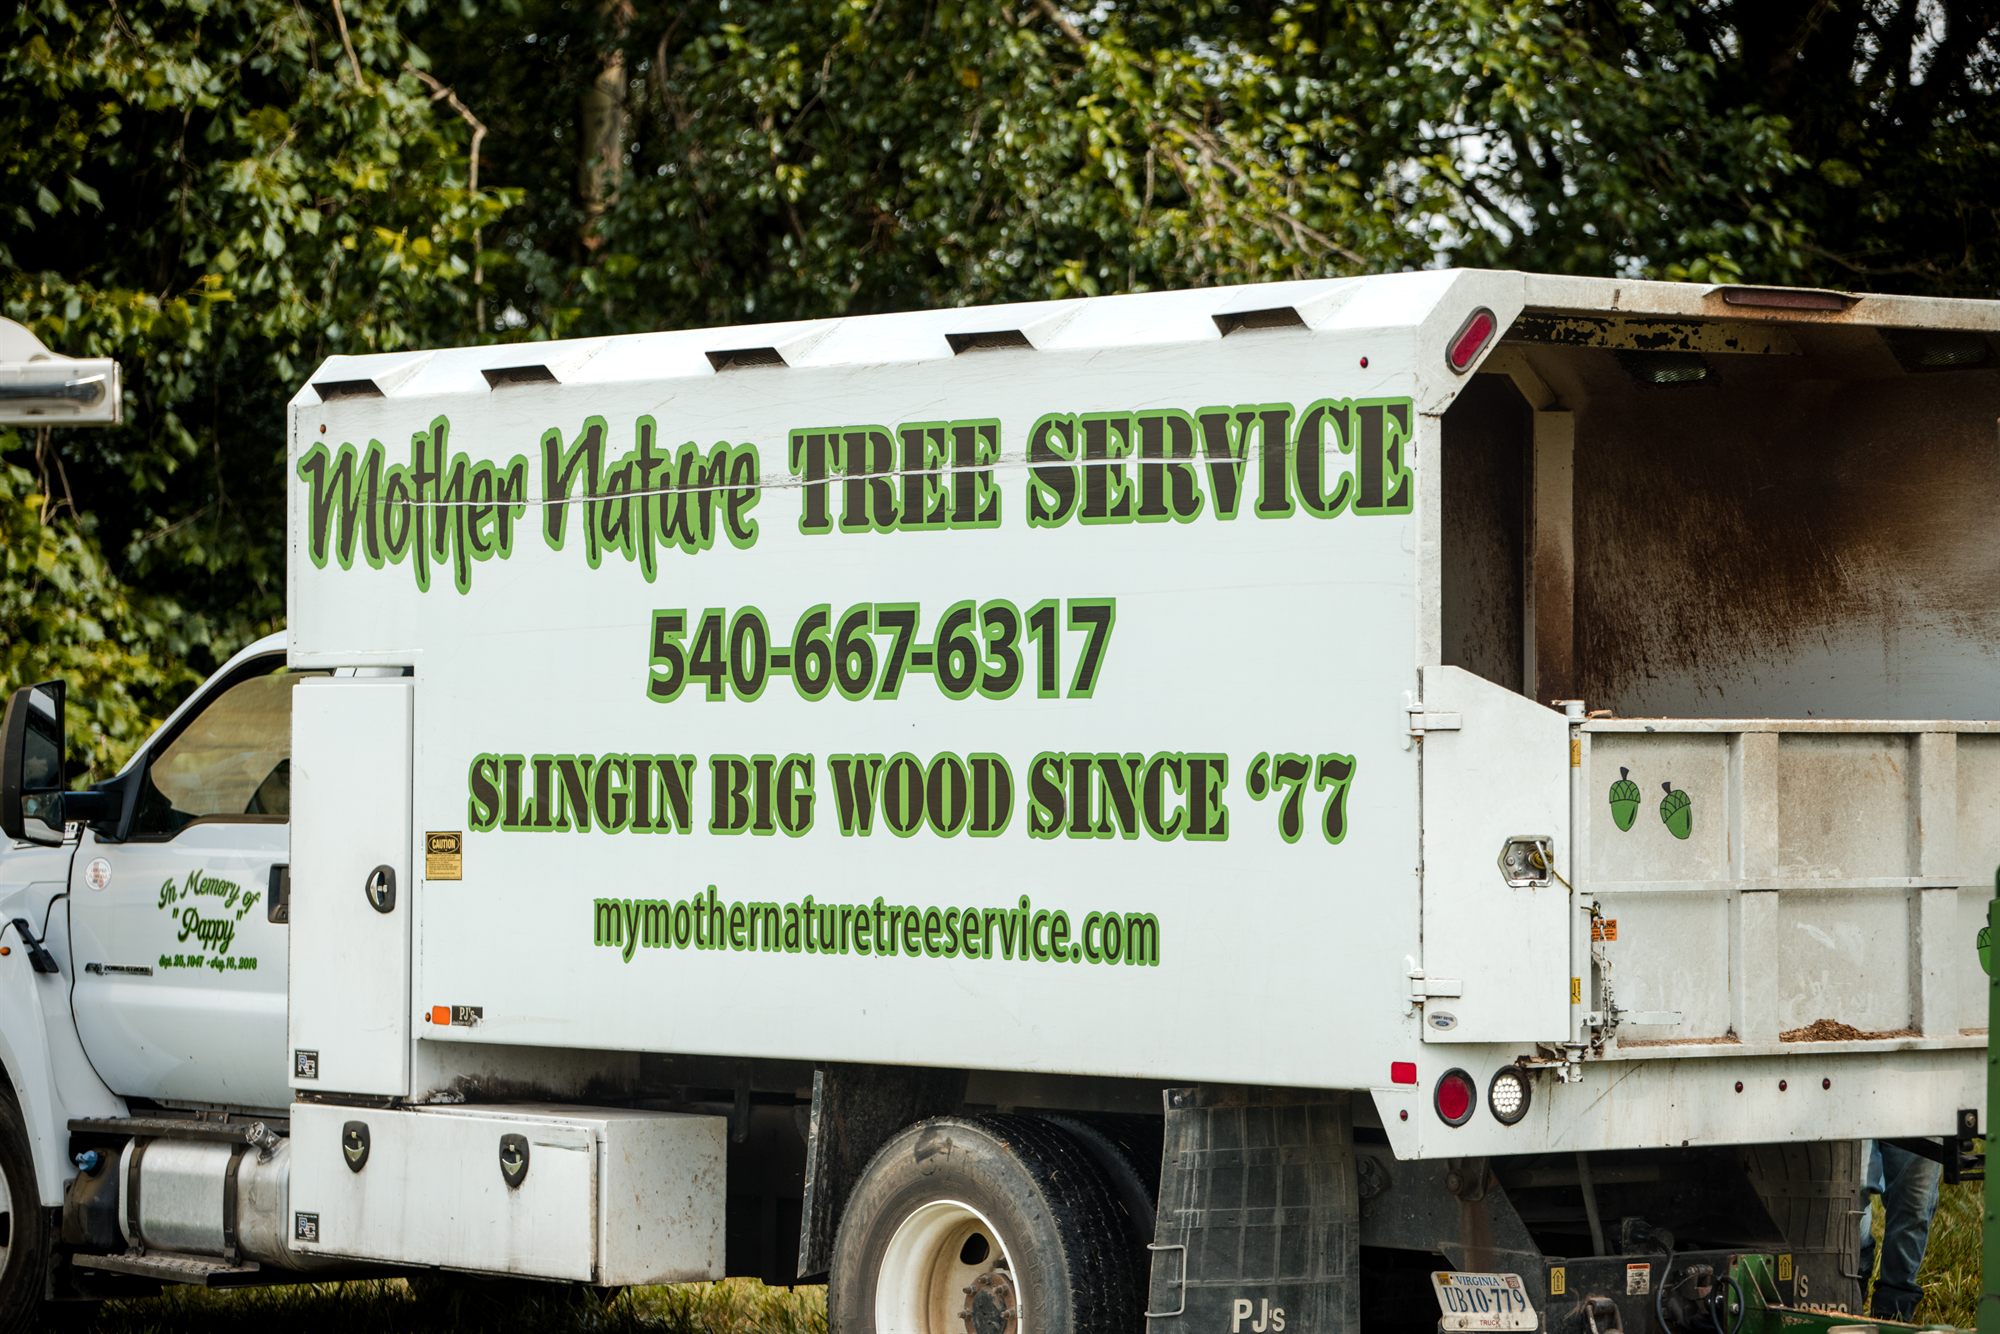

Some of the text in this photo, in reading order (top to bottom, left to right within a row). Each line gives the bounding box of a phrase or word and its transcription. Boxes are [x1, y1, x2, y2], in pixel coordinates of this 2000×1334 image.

[296, 395, 1414, 596] Mother Nature TREE SERVICE
[646, 597, 1118, 704] 540-667-6317
[468, 752, 698, 835] SLINGIN
[708, 753, 816, 839] BIG
[827, 751, 1014, 839] WOOD
[1027, 751, 1230, 842] SINCE
[432, 839, 456, 850] CAUTION
[158, 868, 261, 914] In Memory of
[593, 884, 1161, 967] mymothernaturetreeservice.com
[1456, 1275, 1501, 1286] VIRGINIA
[1232, 1297, 1286, 1334] PJ's
[1479, 1319, 1501, 1327] TRUCK
